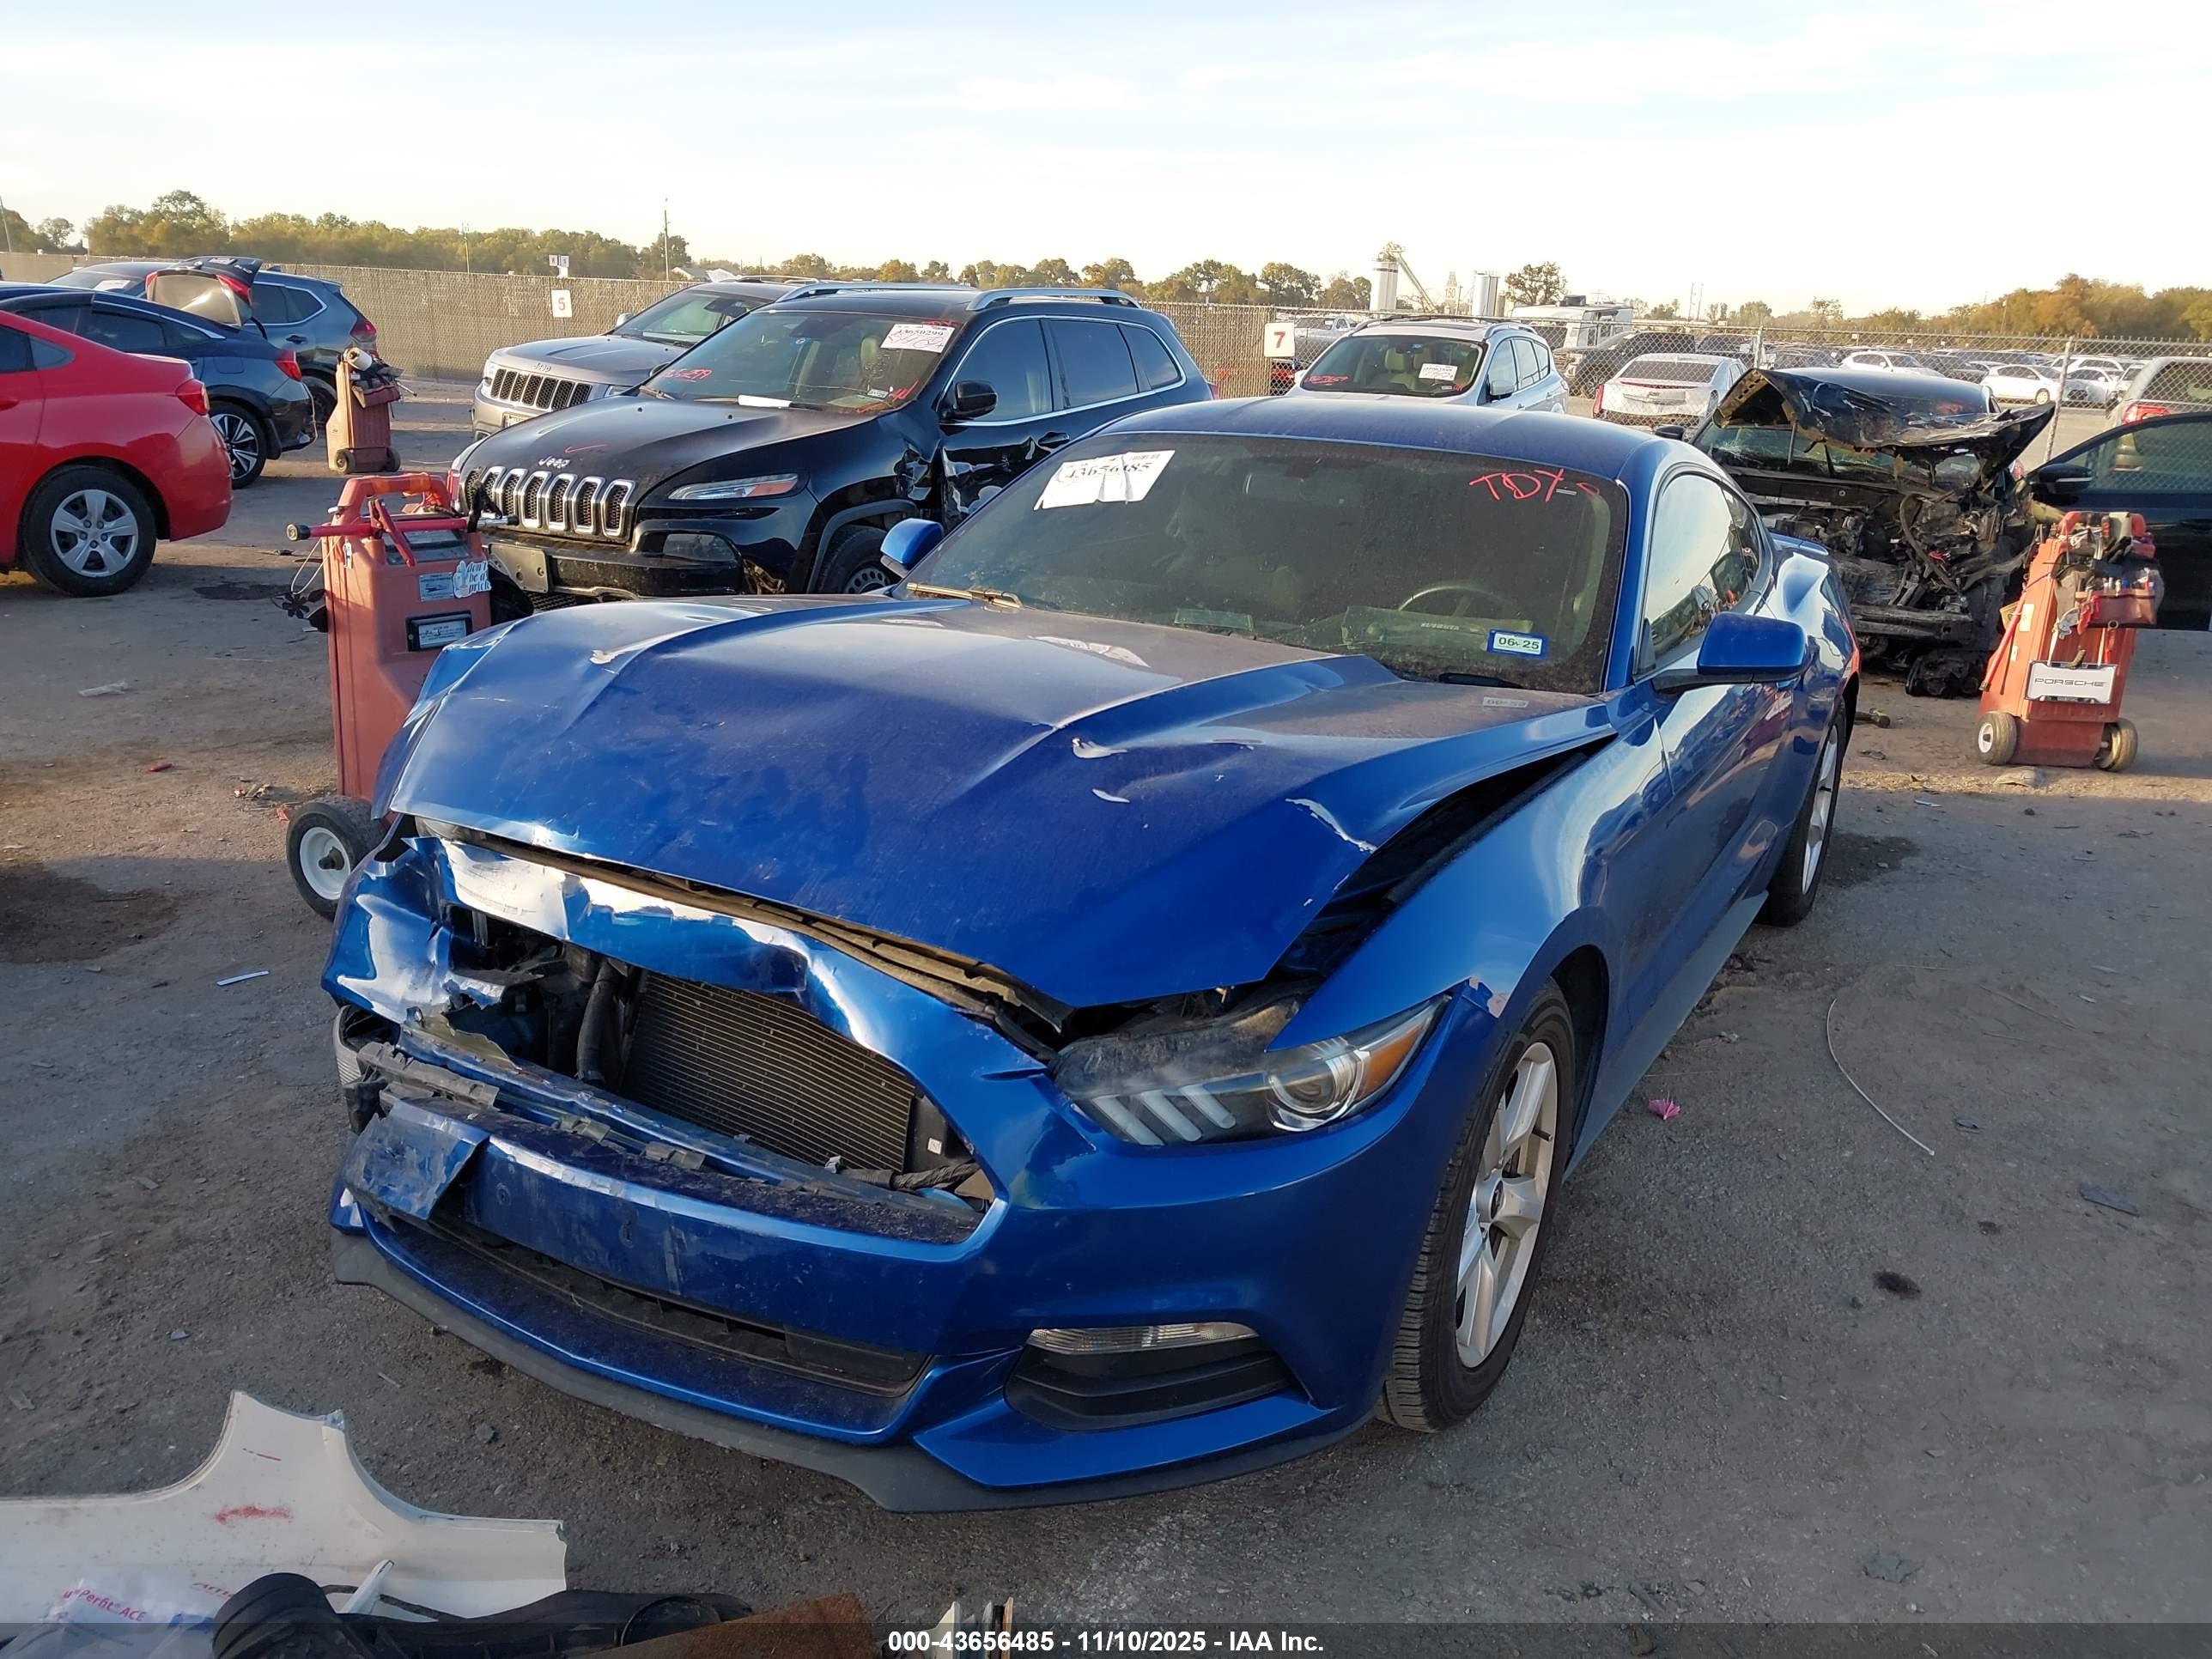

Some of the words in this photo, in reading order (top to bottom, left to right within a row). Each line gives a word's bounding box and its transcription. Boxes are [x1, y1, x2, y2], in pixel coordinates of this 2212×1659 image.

[558, 297, 566, 311] 5
[1273, 331, 1286, 349] 7
[538, 455, 571, 469] Jeep
[469, 580, 490, 592] prick
[2034, 678, 2106, 687] PORSCHE
[118, 1607, 147, 1622] ACE
